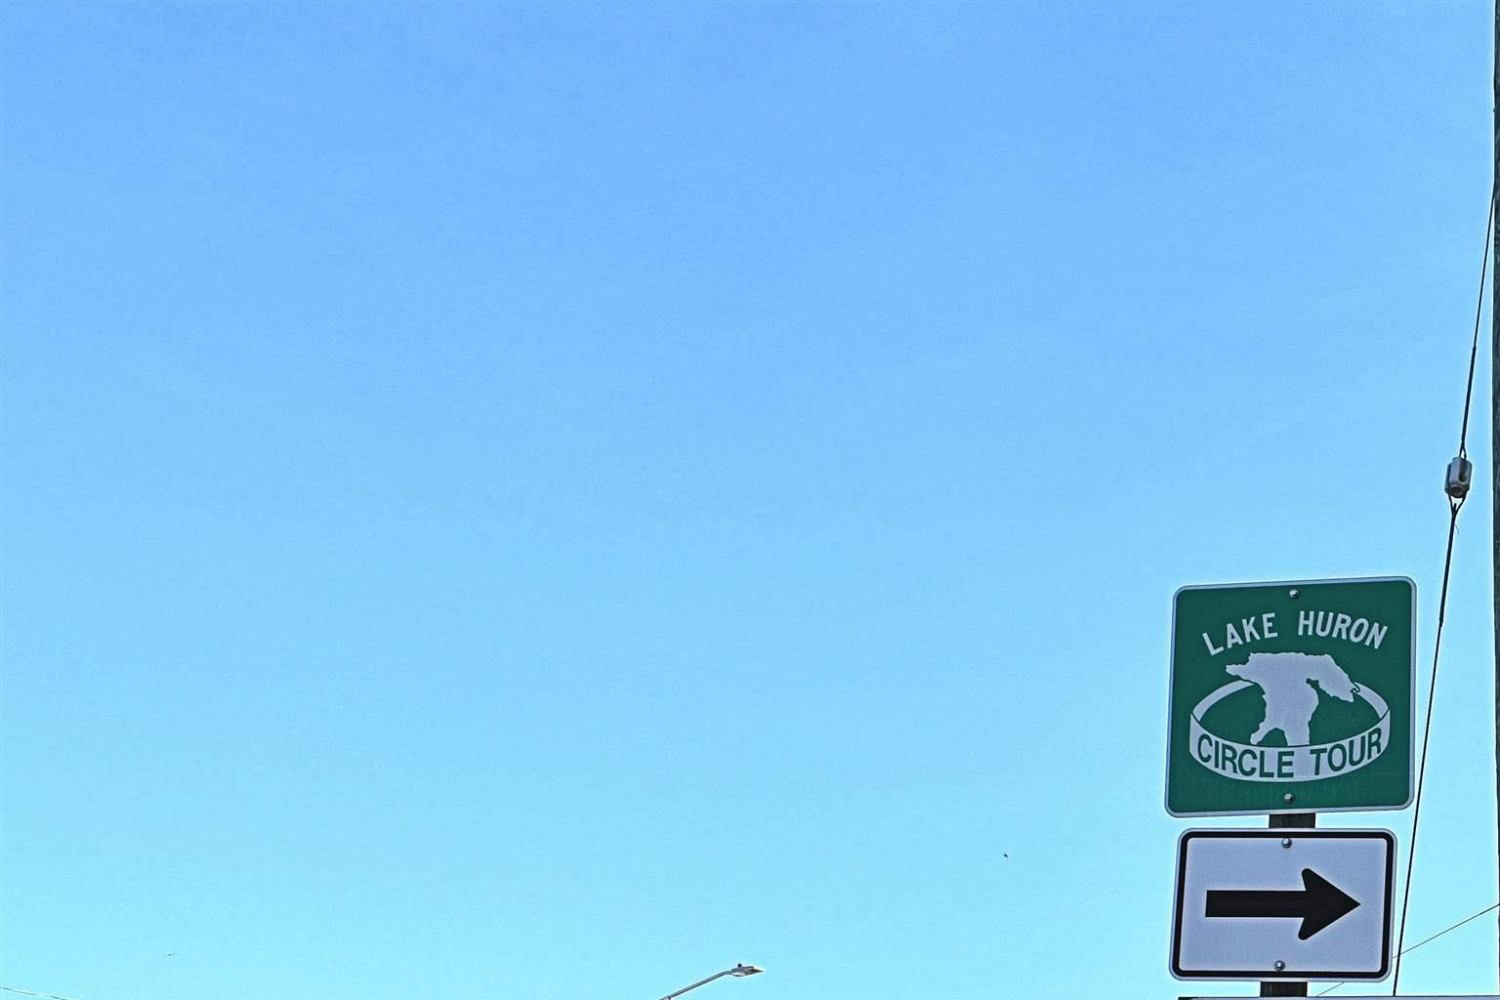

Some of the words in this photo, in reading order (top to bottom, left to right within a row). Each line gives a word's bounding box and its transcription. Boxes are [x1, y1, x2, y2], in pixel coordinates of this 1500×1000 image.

[1202, 612, 1279, 656] LAKE
[1298, 610, 1389, 650] HURON
[1197, 733, 1296, 779] CIRCLE
[1309, 727, 1383, 777] TOUR
